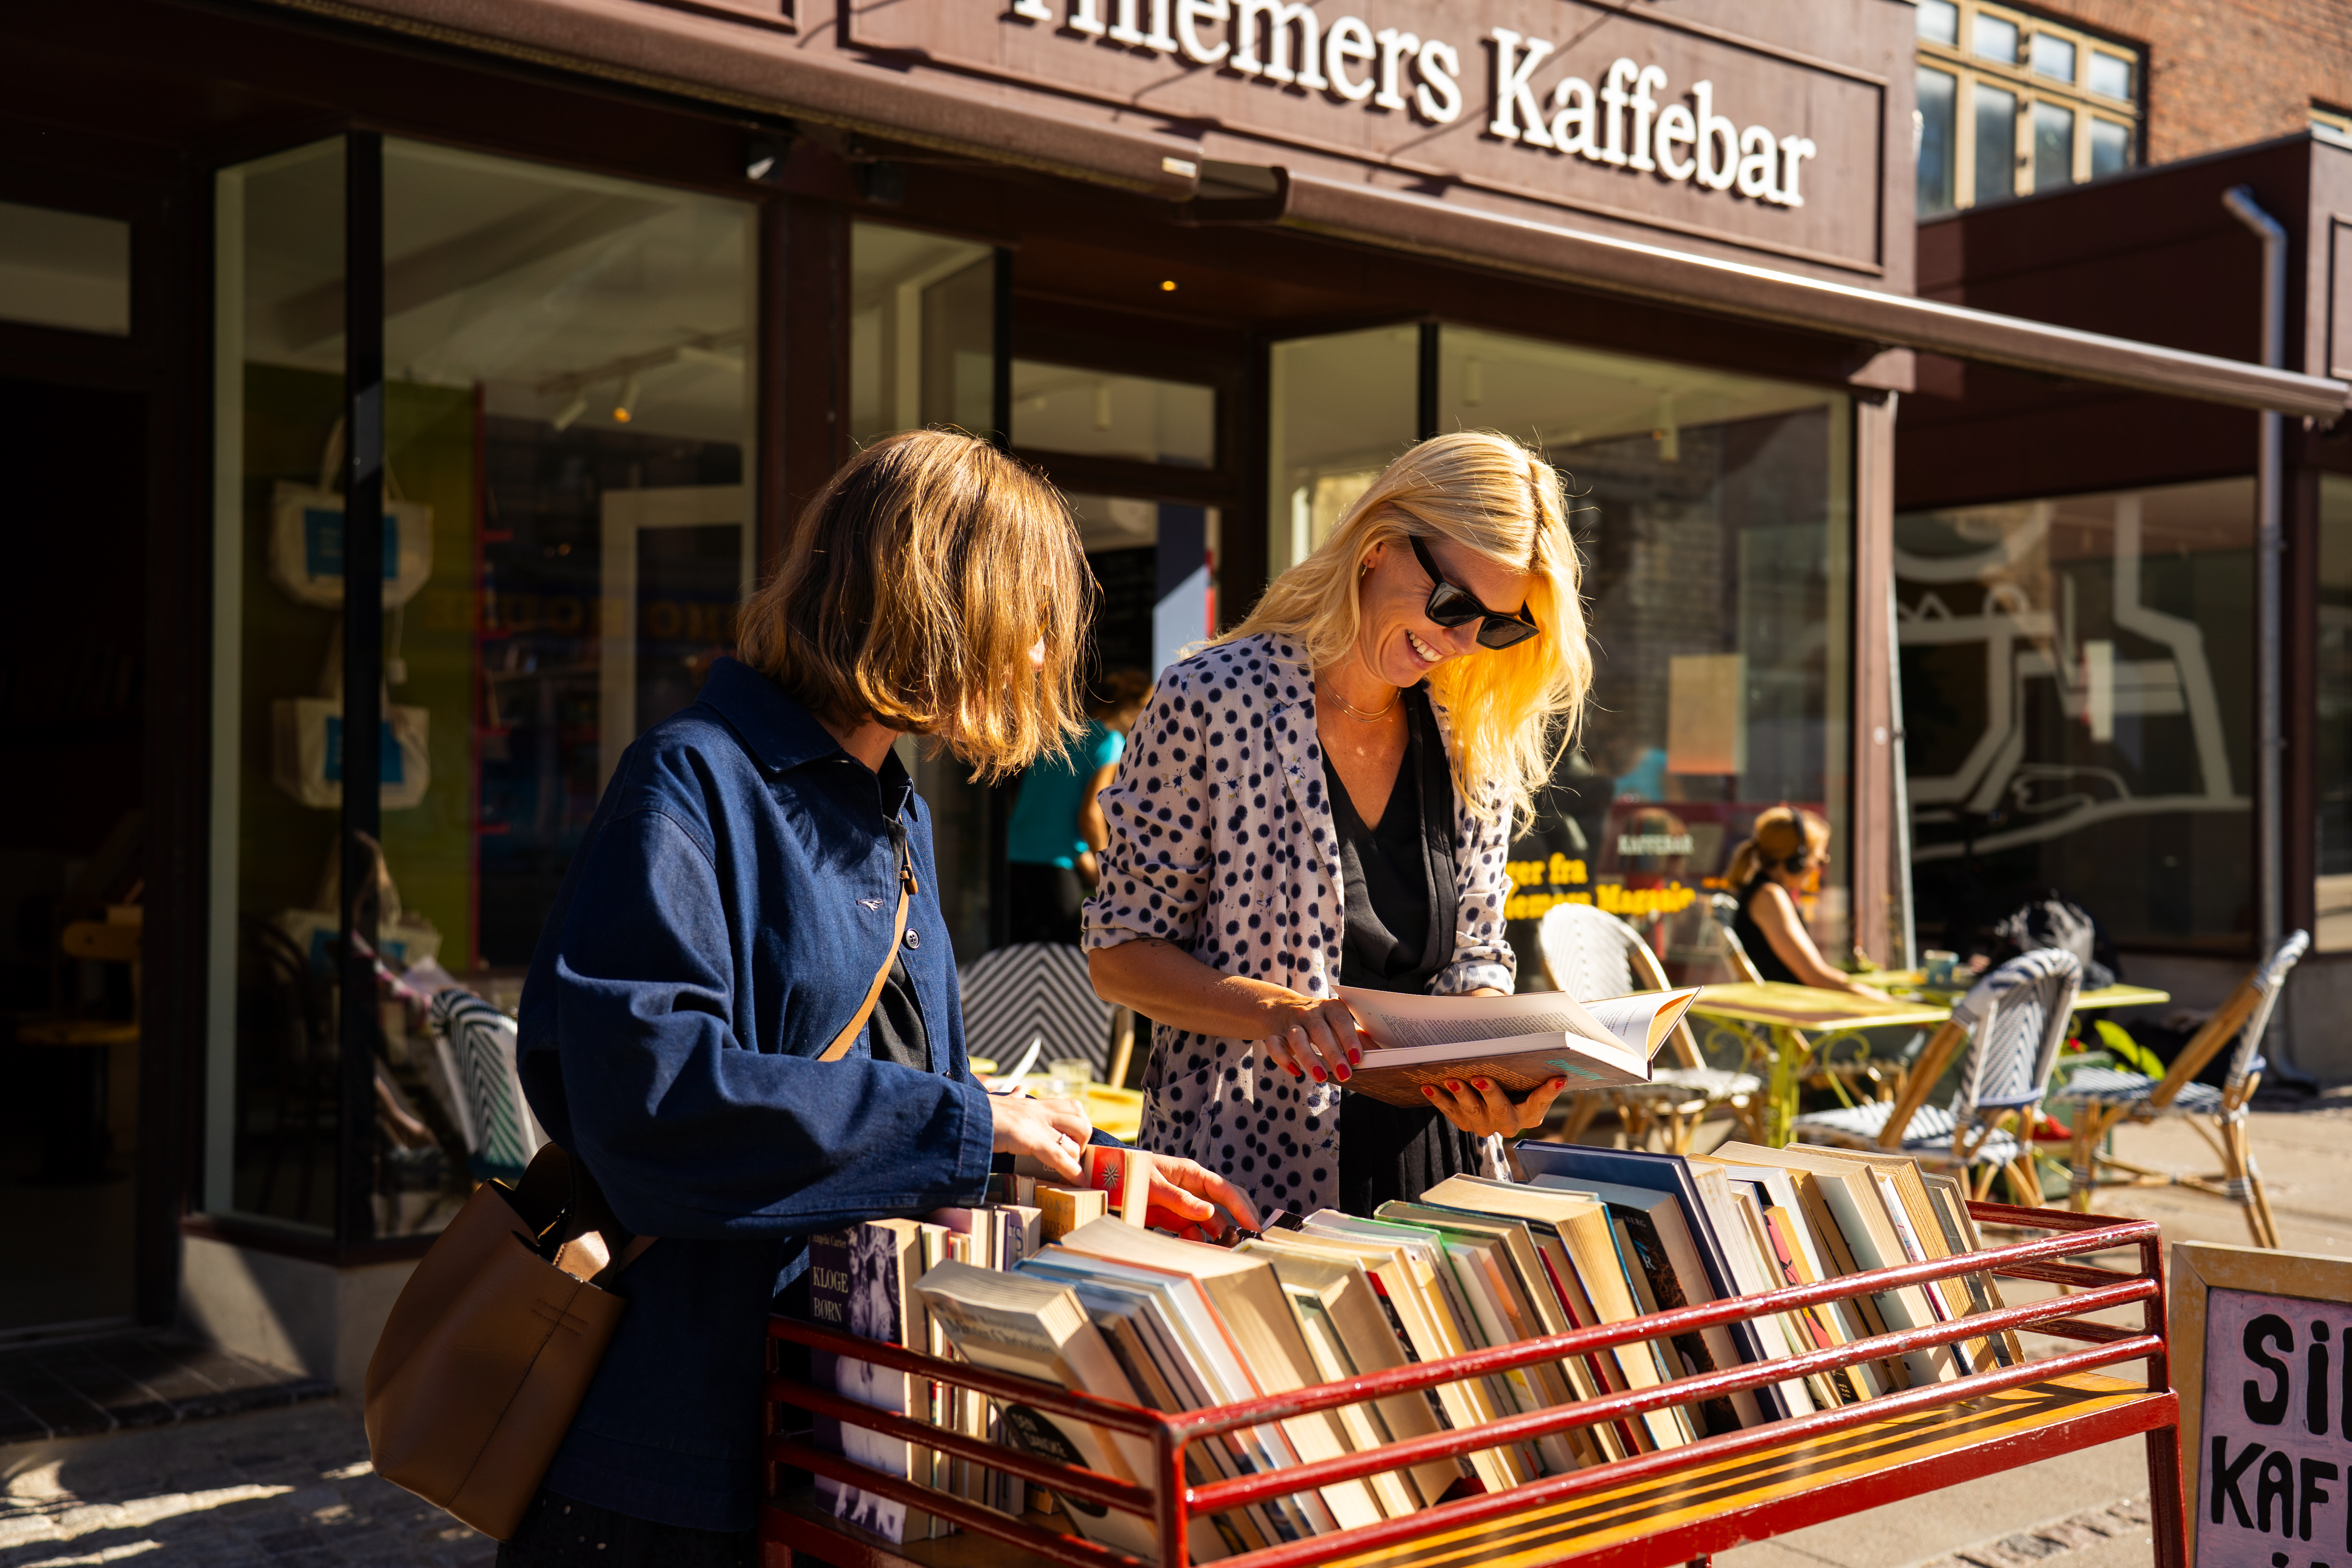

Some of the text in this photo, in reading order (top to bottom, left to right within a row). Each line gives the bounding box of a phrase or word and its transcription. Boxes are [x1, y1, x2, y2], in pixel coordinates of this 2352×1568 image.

[1016, 0, 1817, 208] emers Kaffebar
[813, 1266, 848, 1293] KLOGE
[814, 1297, 842, 1323] BØRN
[2243, 1314, 2352, 1442] Si
[2211, 1435, 2352, 1554] KAF
